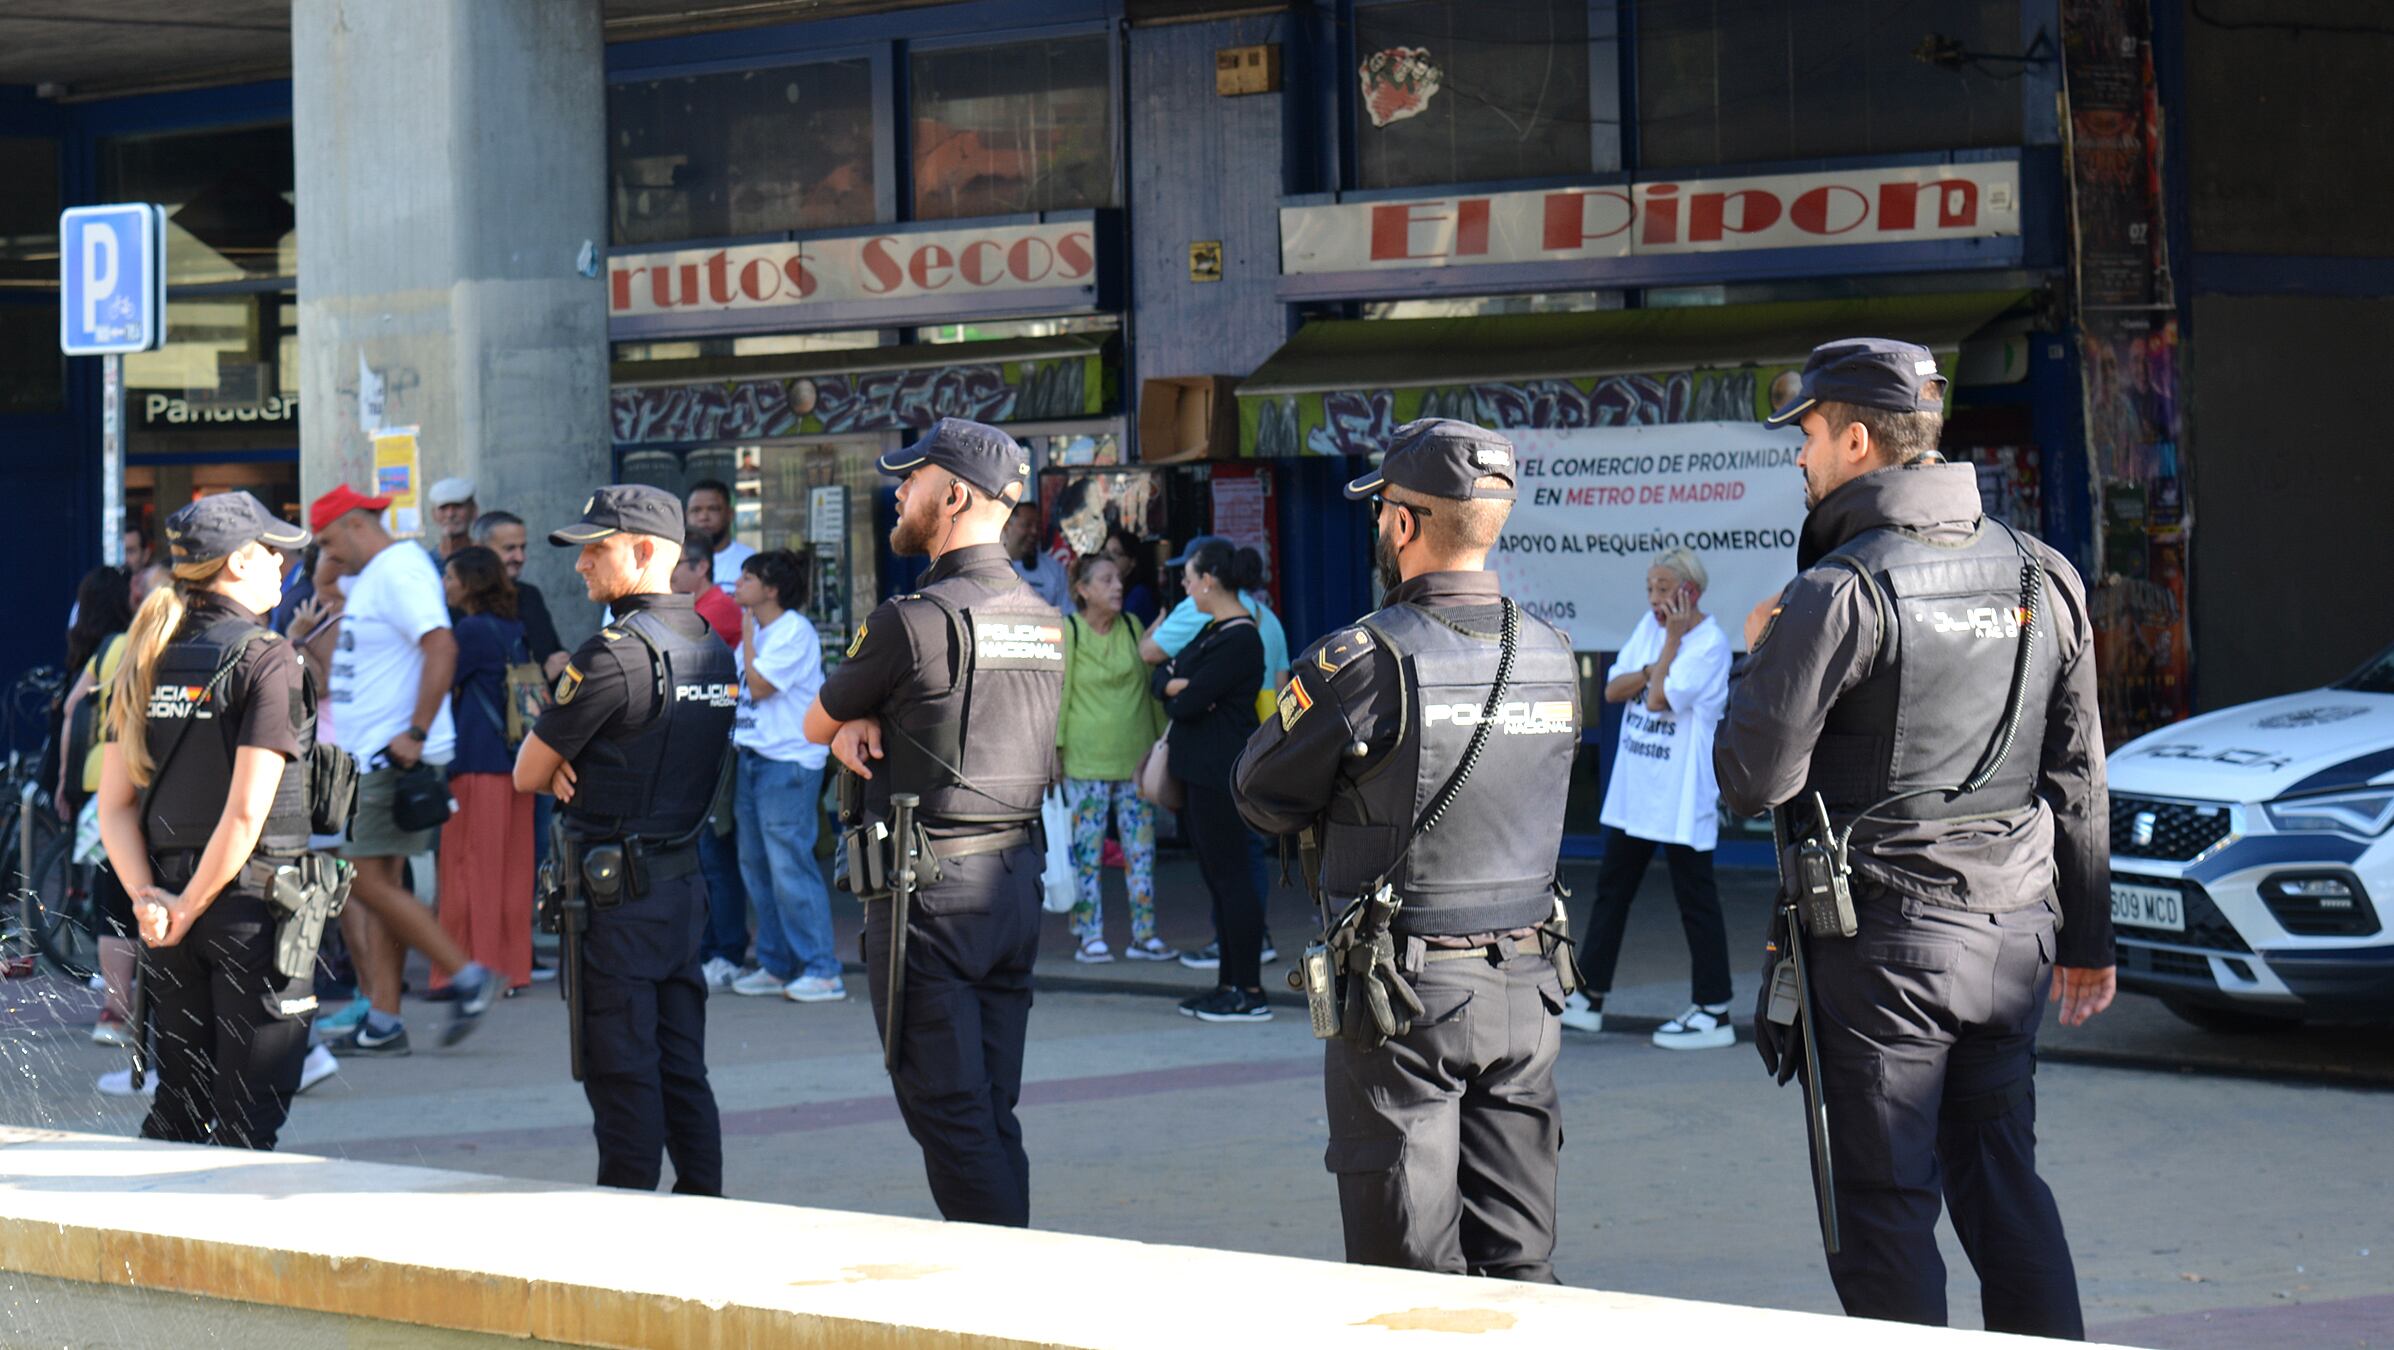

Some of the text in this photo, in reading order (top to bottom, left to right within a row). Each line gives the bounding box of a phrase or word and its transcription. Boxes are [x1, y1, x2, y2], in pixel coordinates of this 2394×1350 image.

[1370, 179, 1978, 261] El Pipon
[861, 232, 1094, 294] Secos
[83, 222, 119, 334] P
[1524, 459, 1546, 477] EL
[1551, 455, 1654, 476] COMERCIO
[1658, 454, 1684, 474] DE
[1534, 481, 1745, 506] EN METRO DE MADRID
[1499, 527, 1795, 556] APOYO AL PEQUEÑO COMERCIO
[676, 684, 729, 702] POLICIA
[1425, 702, 1550, 727] POLICIA
[2144, 896, 2177, 924] MCD
